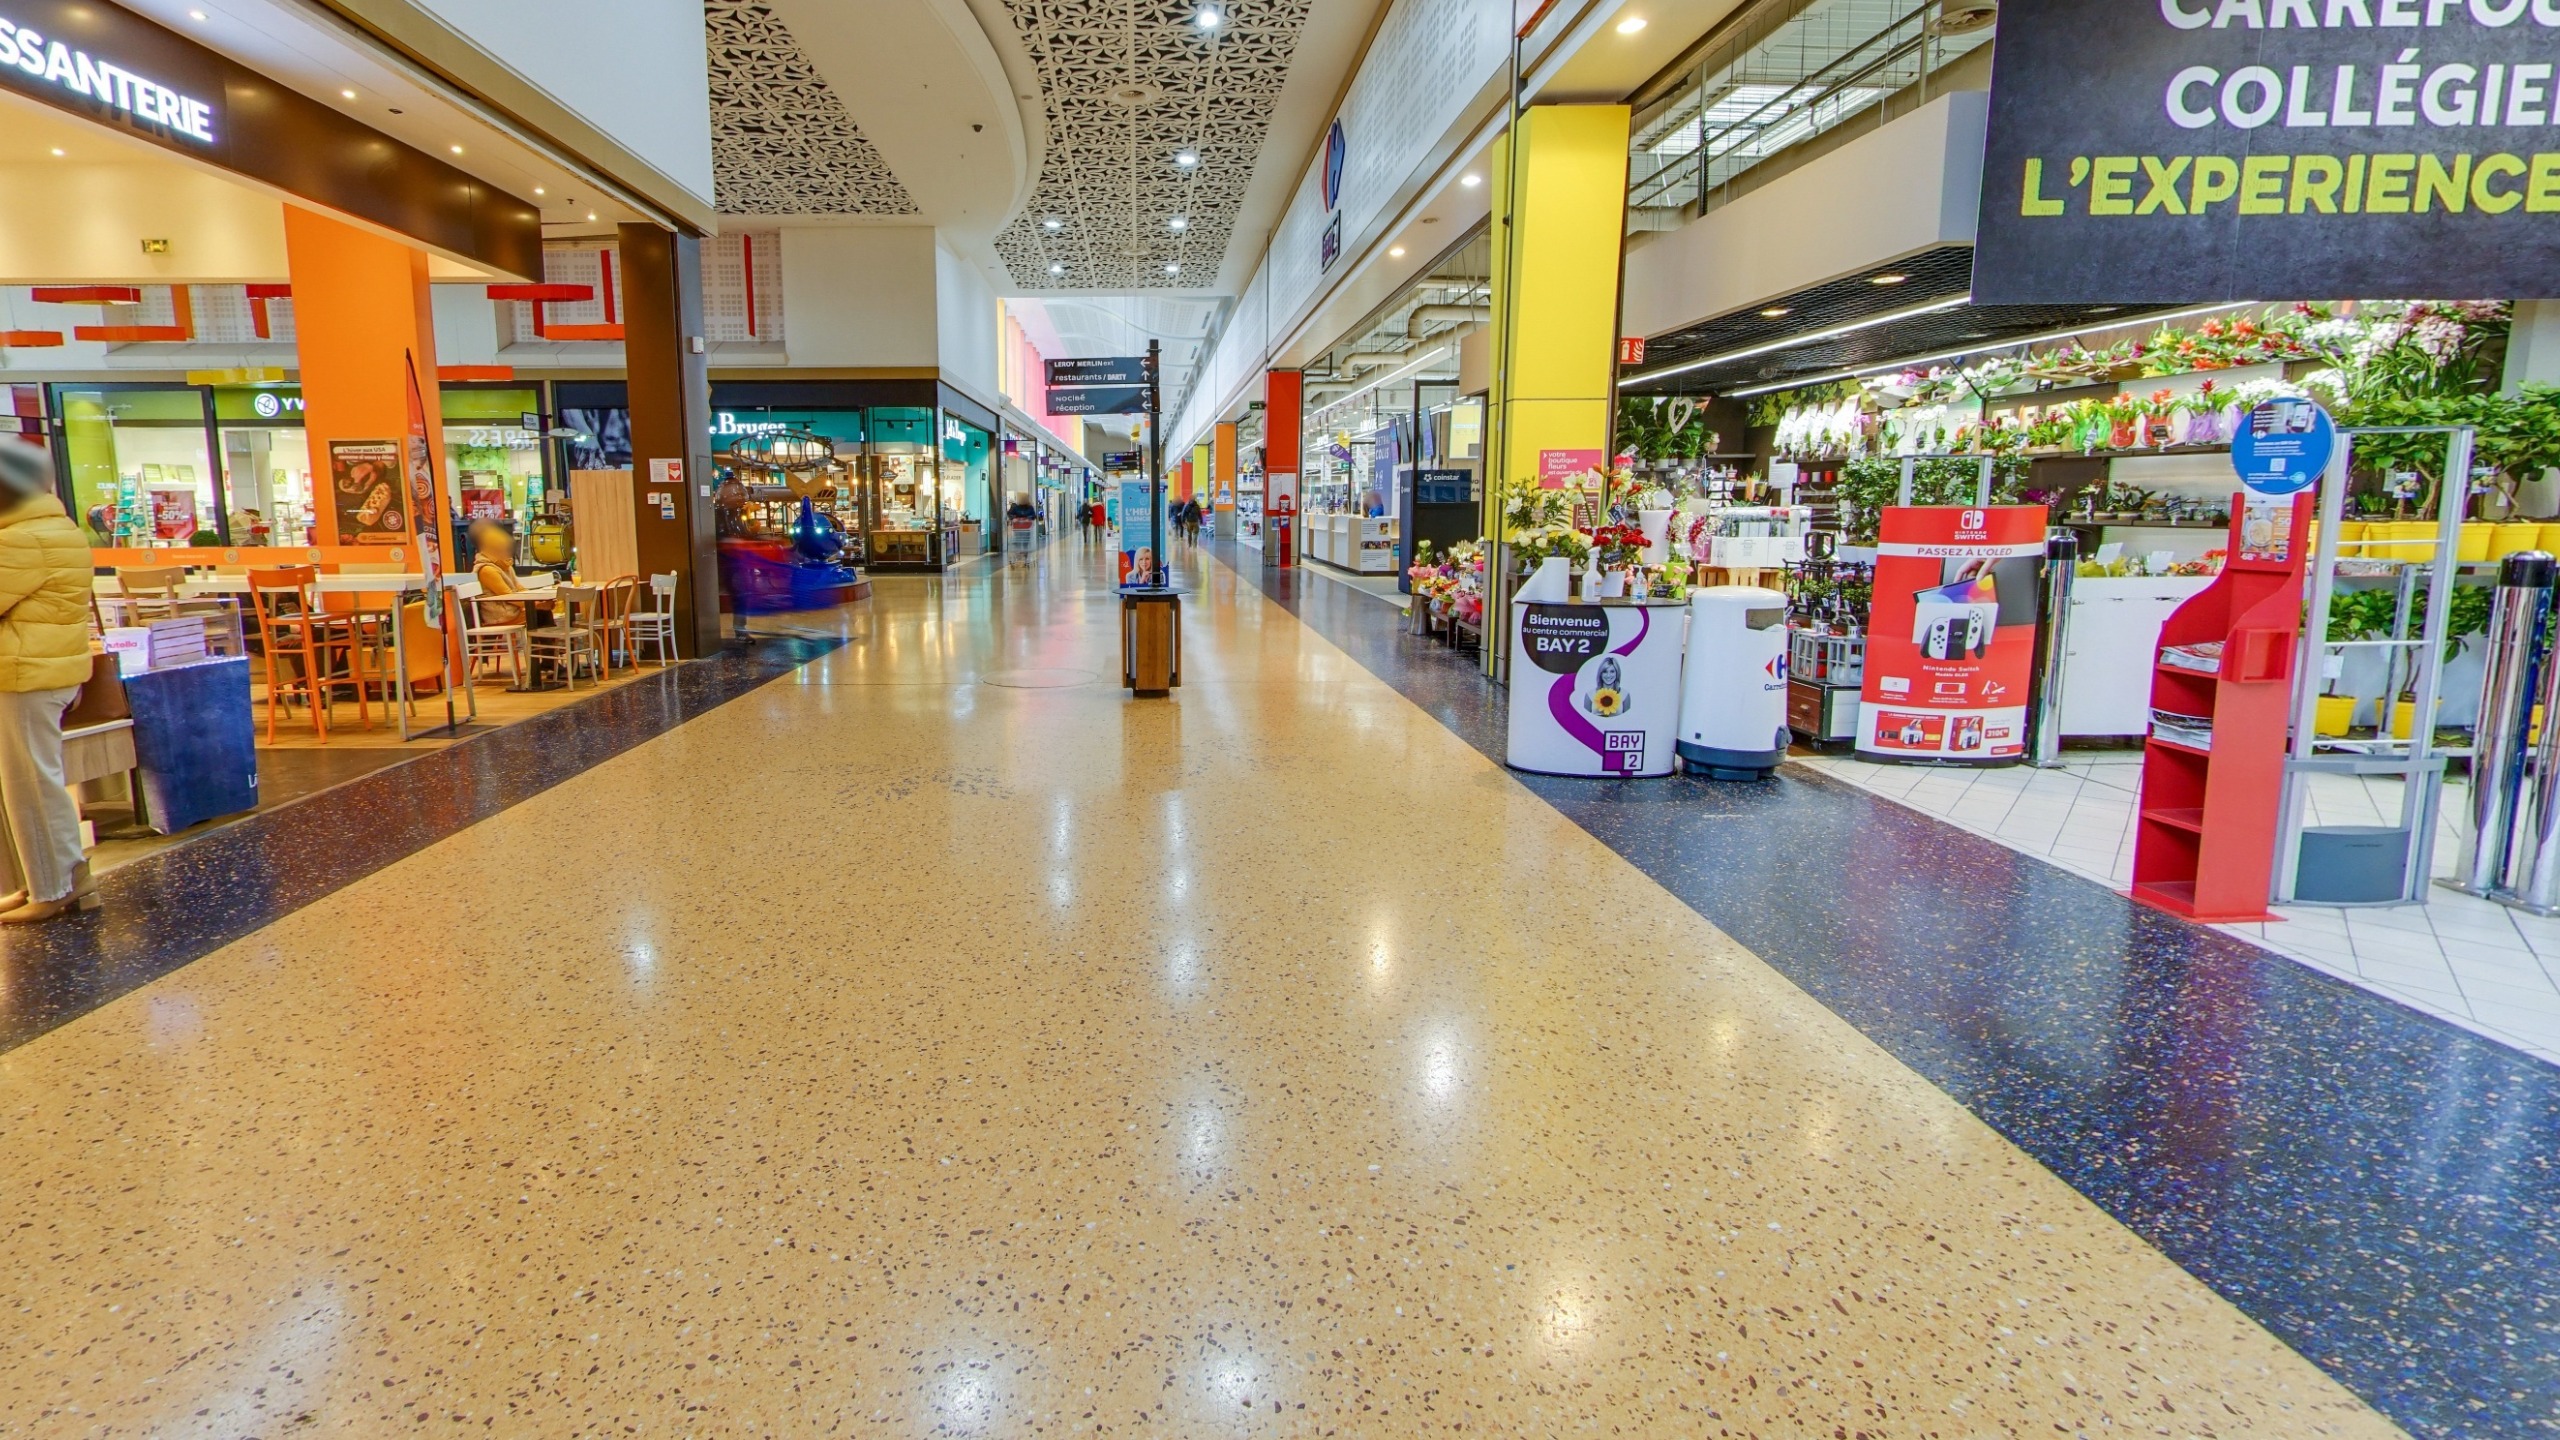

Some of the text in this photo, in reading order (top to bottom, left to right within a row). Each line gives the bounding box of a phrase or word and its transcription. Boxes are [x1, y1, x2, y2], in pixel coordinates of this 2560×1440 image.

[2159, 0, 2560, 29] CARREFO
[2166, 48, 2560, 128] COLLÉGIE
[1055, 404, 1095, 412] réception
[718, 412, 787, 440] Bruges
[1917, 545, 2013, 556] PASSEZ À L'OLED
[1529, 614, 1601, 627] Bienvenue
[1532, 627, 1558, 635] centre
[1559, 629, 1608, 637] commercial
[1537, 637, 1591, 653] BAY 2
[1609, 735, 1640, 748] BAY
[1629, 754, 1638, 768] 2
